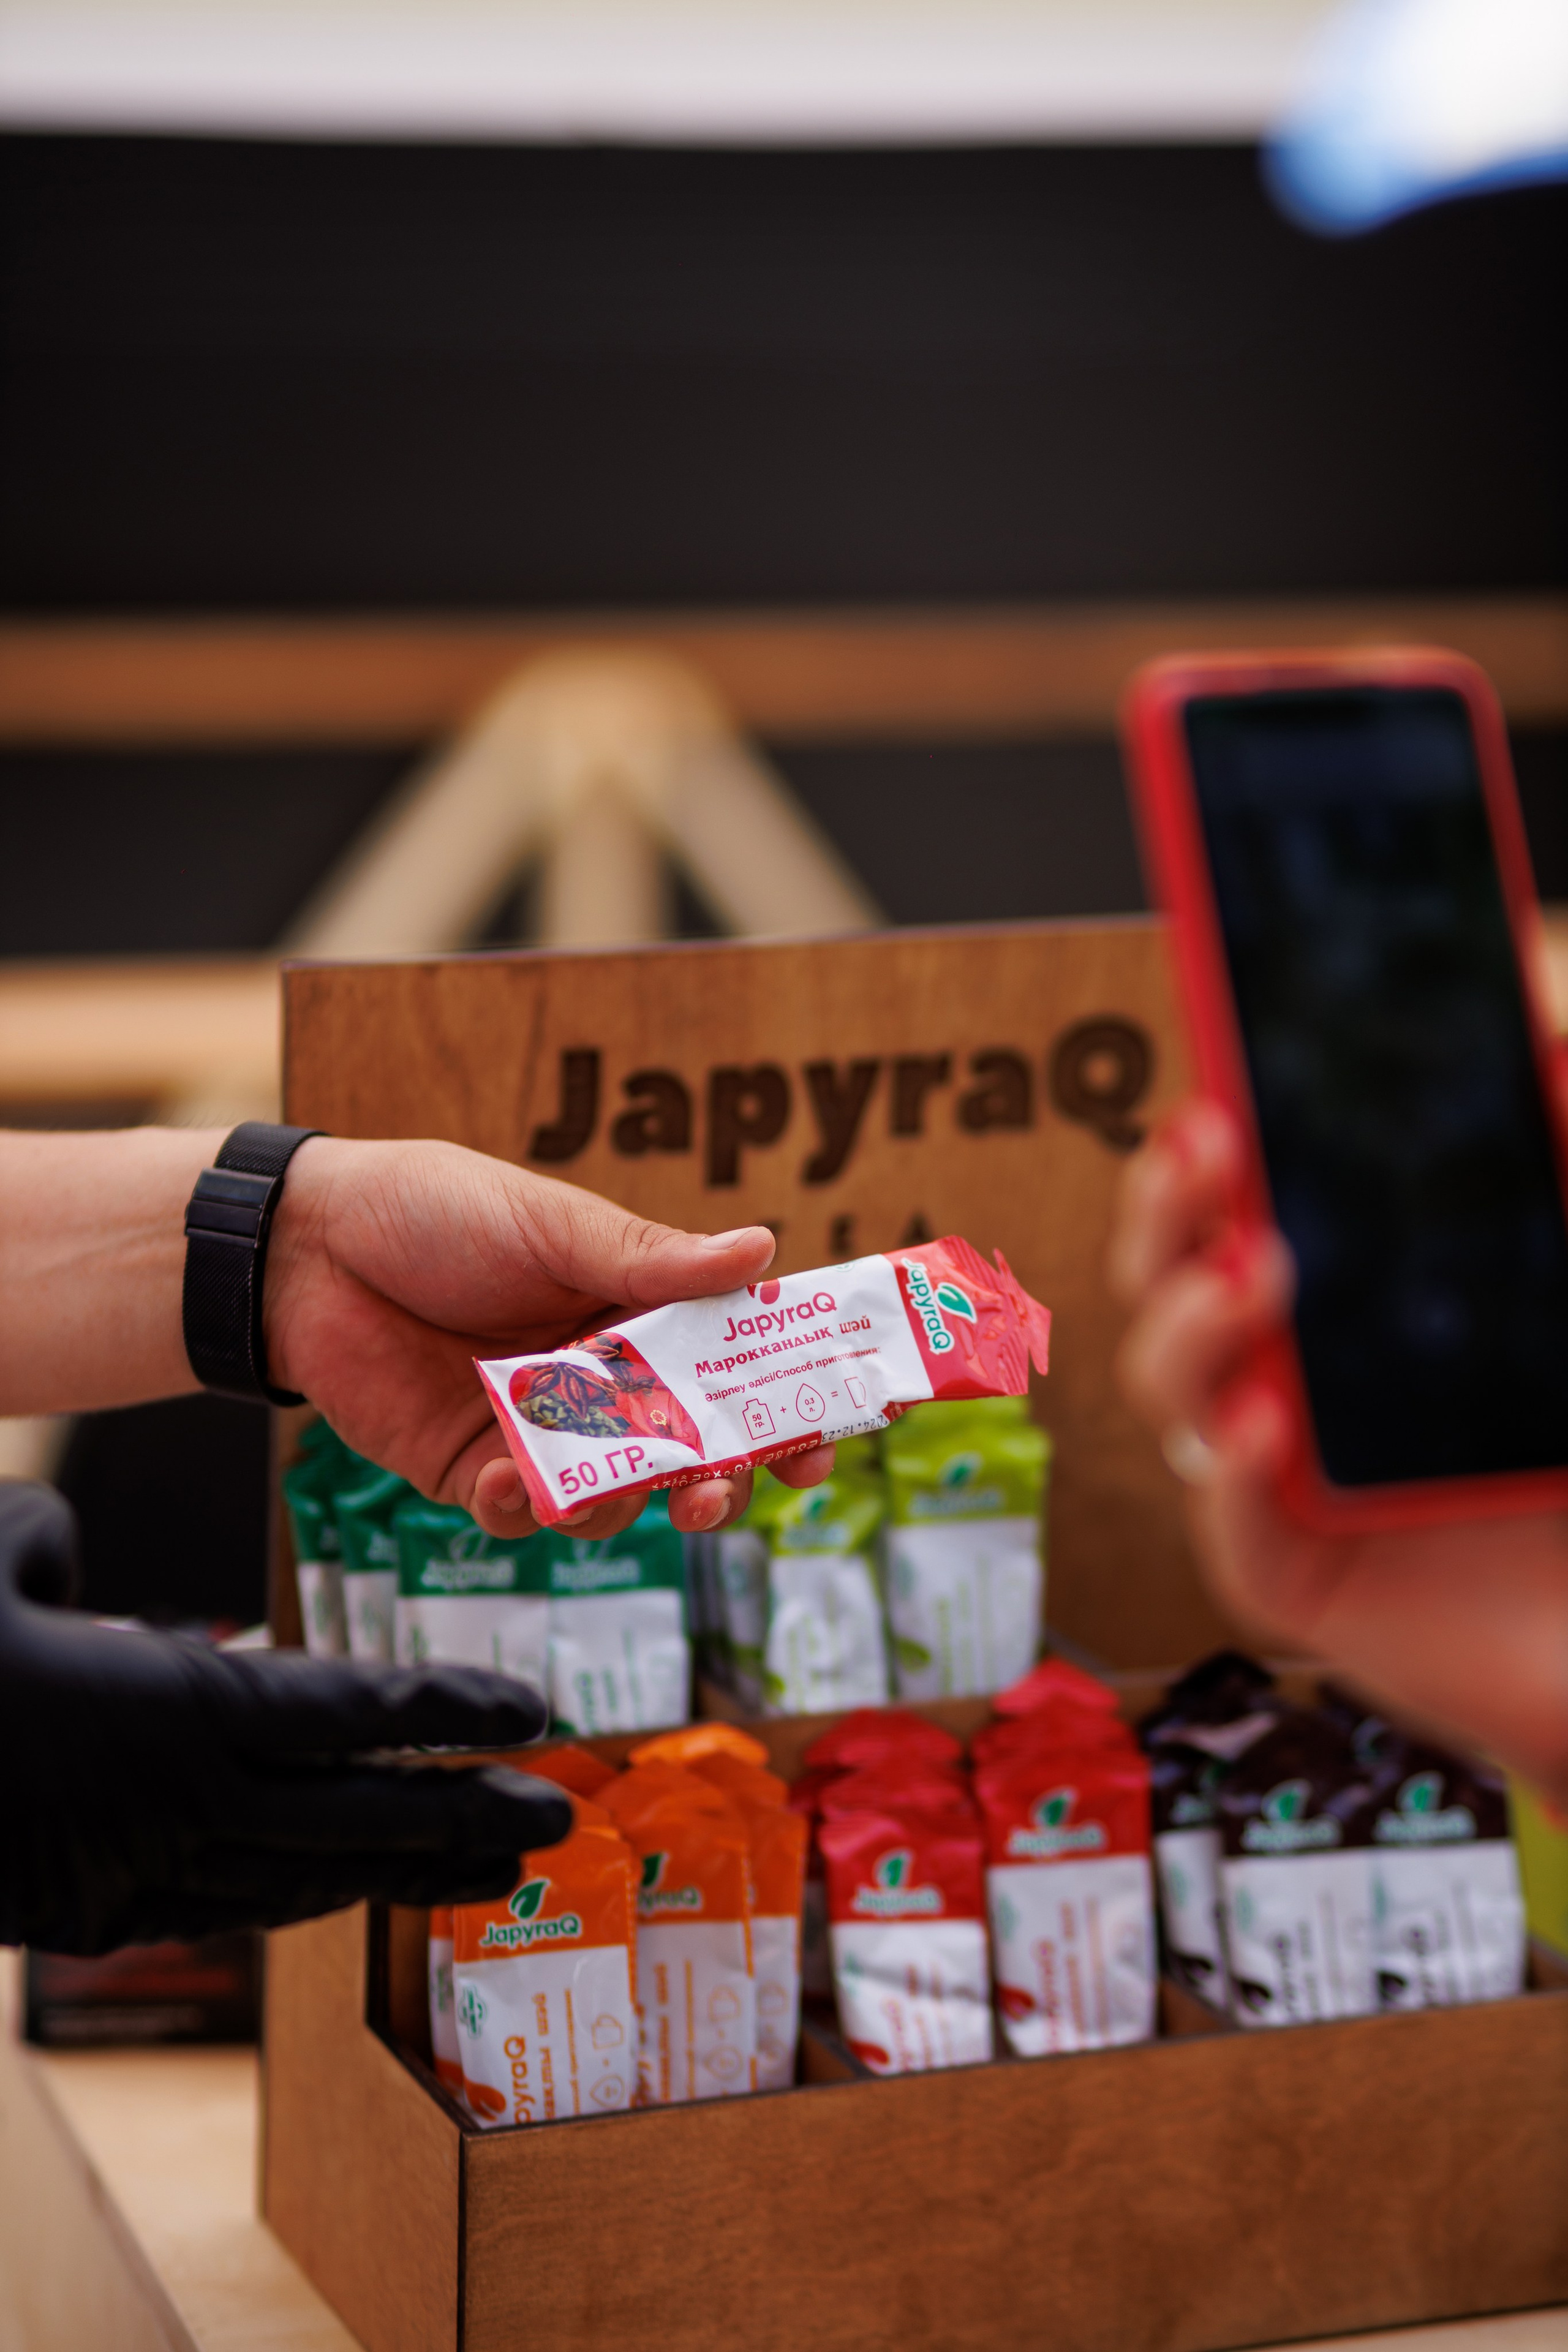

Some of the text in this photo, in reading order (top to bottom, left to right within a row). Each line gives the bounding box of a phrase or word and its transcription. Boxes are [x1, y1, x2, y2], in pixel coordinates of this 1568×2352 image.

[527, 1016, 1155, 1187] JapyraQ
[723, 1292, 837, 1341] JapyraQ
[904, 1259, 951, 1350] JapyraQ
[695, 1315, 872, 1378] Мароккандық шәй
[705, 1384, 745, 1402] Әзірлеу
[752, 1413, 762, 1422] 50
[804, 1397, 815, 1406] 0.3
[755, 1420, 765, 1428] гр.
[558, 1461, 598, 1494] 50
[605, 1445, 654, 1479] ГР.
[481, 1915, 579, 1947] JapyraQ
[503, 2035, 537, 2124] pyraQ
